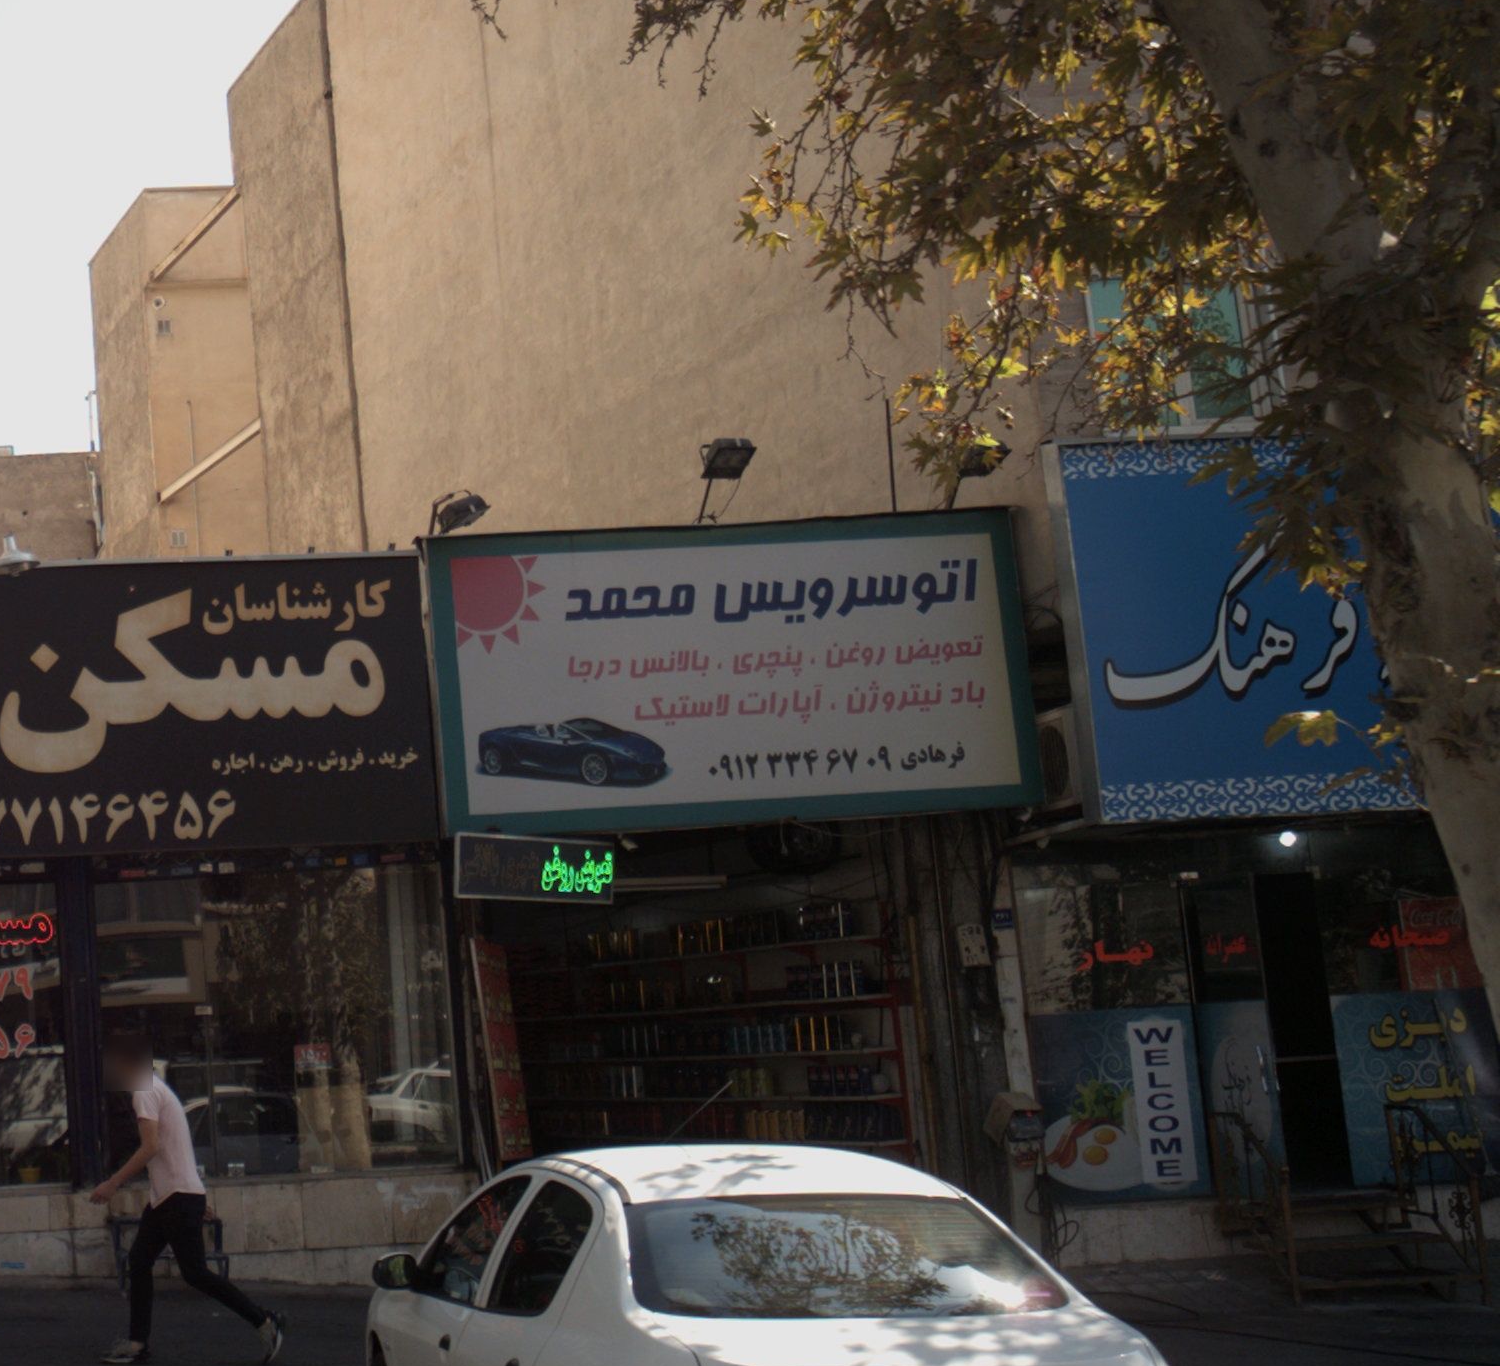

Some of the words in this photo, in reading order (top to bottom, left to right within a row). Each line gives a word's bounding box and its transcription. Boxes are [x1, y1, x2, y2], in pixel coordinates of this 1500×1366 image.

[565, 582, 695, 623] محمد
[714, 558, 977, 624] اتوسرویس
[202, 580, 391, 633] کارشناسان
[629, 651, 710, 680] بالانس
[733, 647, 801, 678] پنچری
[826, 639, 886, 670] روغن
[895, 634, 984, 667] تعویض
[568, 654, 621, 682] درجا
[634, 691, 730, 727] لاستیک
[738, 685, 822, 725] آپارات
[846, 684, 943, 716] نیتروژن
[950, 682, 986, 709] باد
[211, 752, 255, 776] اجاره
[270, 754, 303, 773] رهن
[317, 747, 364, 772] فروش
[378, 747, 419, 769] خرید
[709, 753, 758, 780] ۰۹۱۲
[766, 748, 819, 778] ۳۳۴
[826, 747, 858, 775] ۶۷
[866, 745, 891, 771] ۰۹
[901, 741, 965, 770] فرهادی
[1369, 1006, 1467, 1049] دیزی
[1385, 1063, 1476, 1103] املت
[1133, 1027, 1182, 1177] WELCOME
